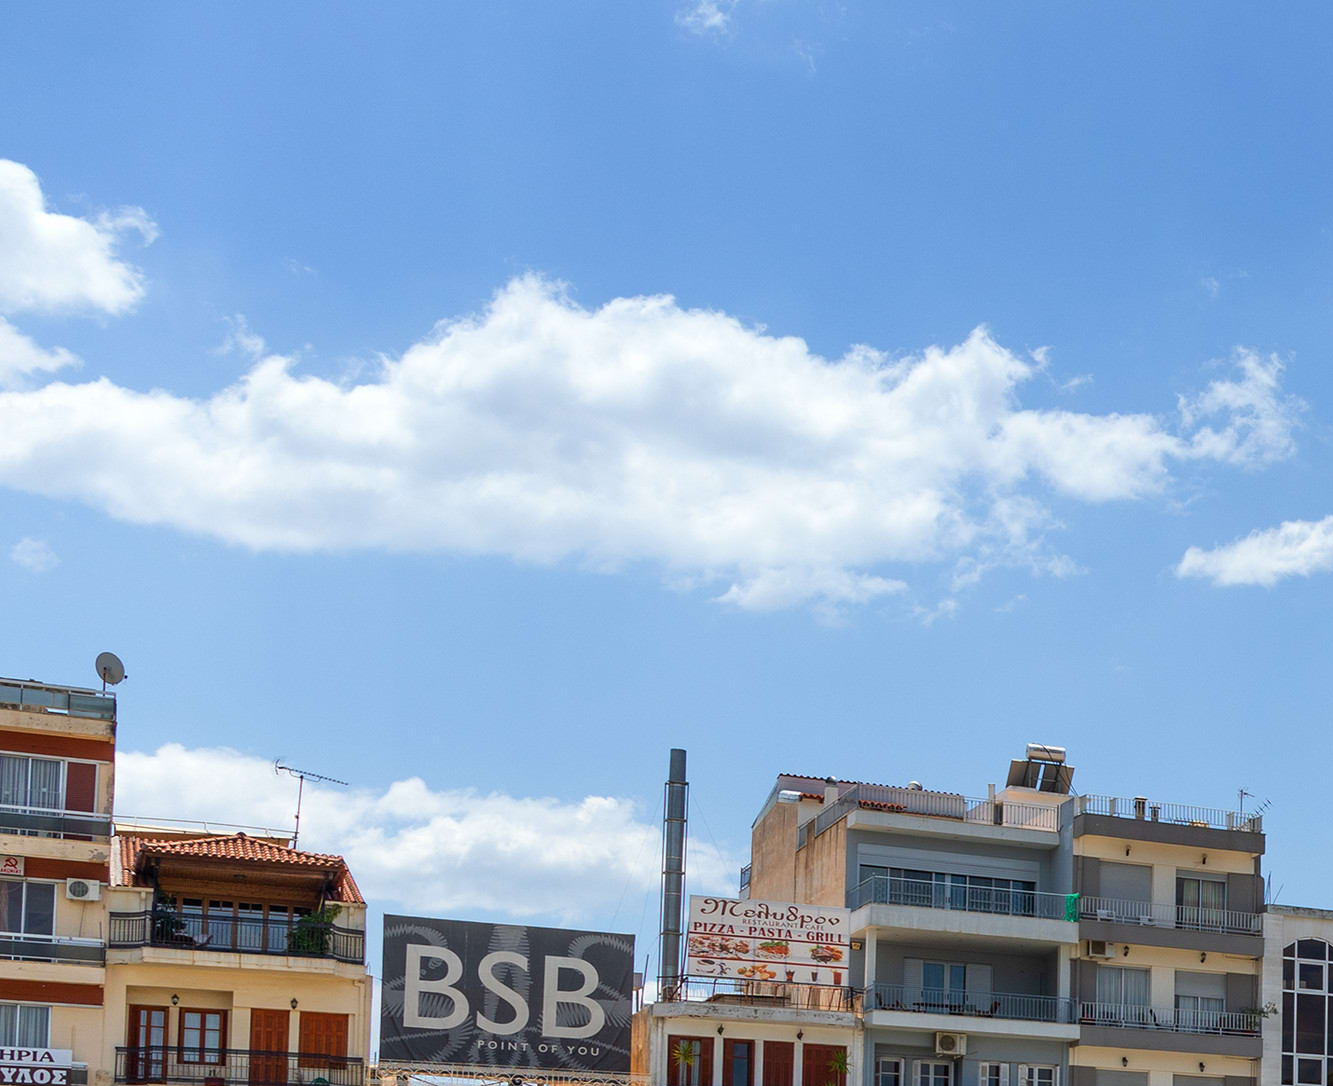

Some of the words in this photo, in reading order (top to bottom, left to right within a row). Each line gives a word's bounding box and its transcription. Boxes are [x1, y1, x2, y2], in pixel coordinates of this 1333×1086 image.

[693, 921, 735, 934] PIZZA
[748, 926, 793, 939] PASTA
[806, 931, 845, 943] GRILL
[403, 943, 606, 1039] BSB
[477, 1039, 529, 1052] POINT
[538, 1043, 558, 1054] OF
[567, 1045, 600, 1057] YOU
